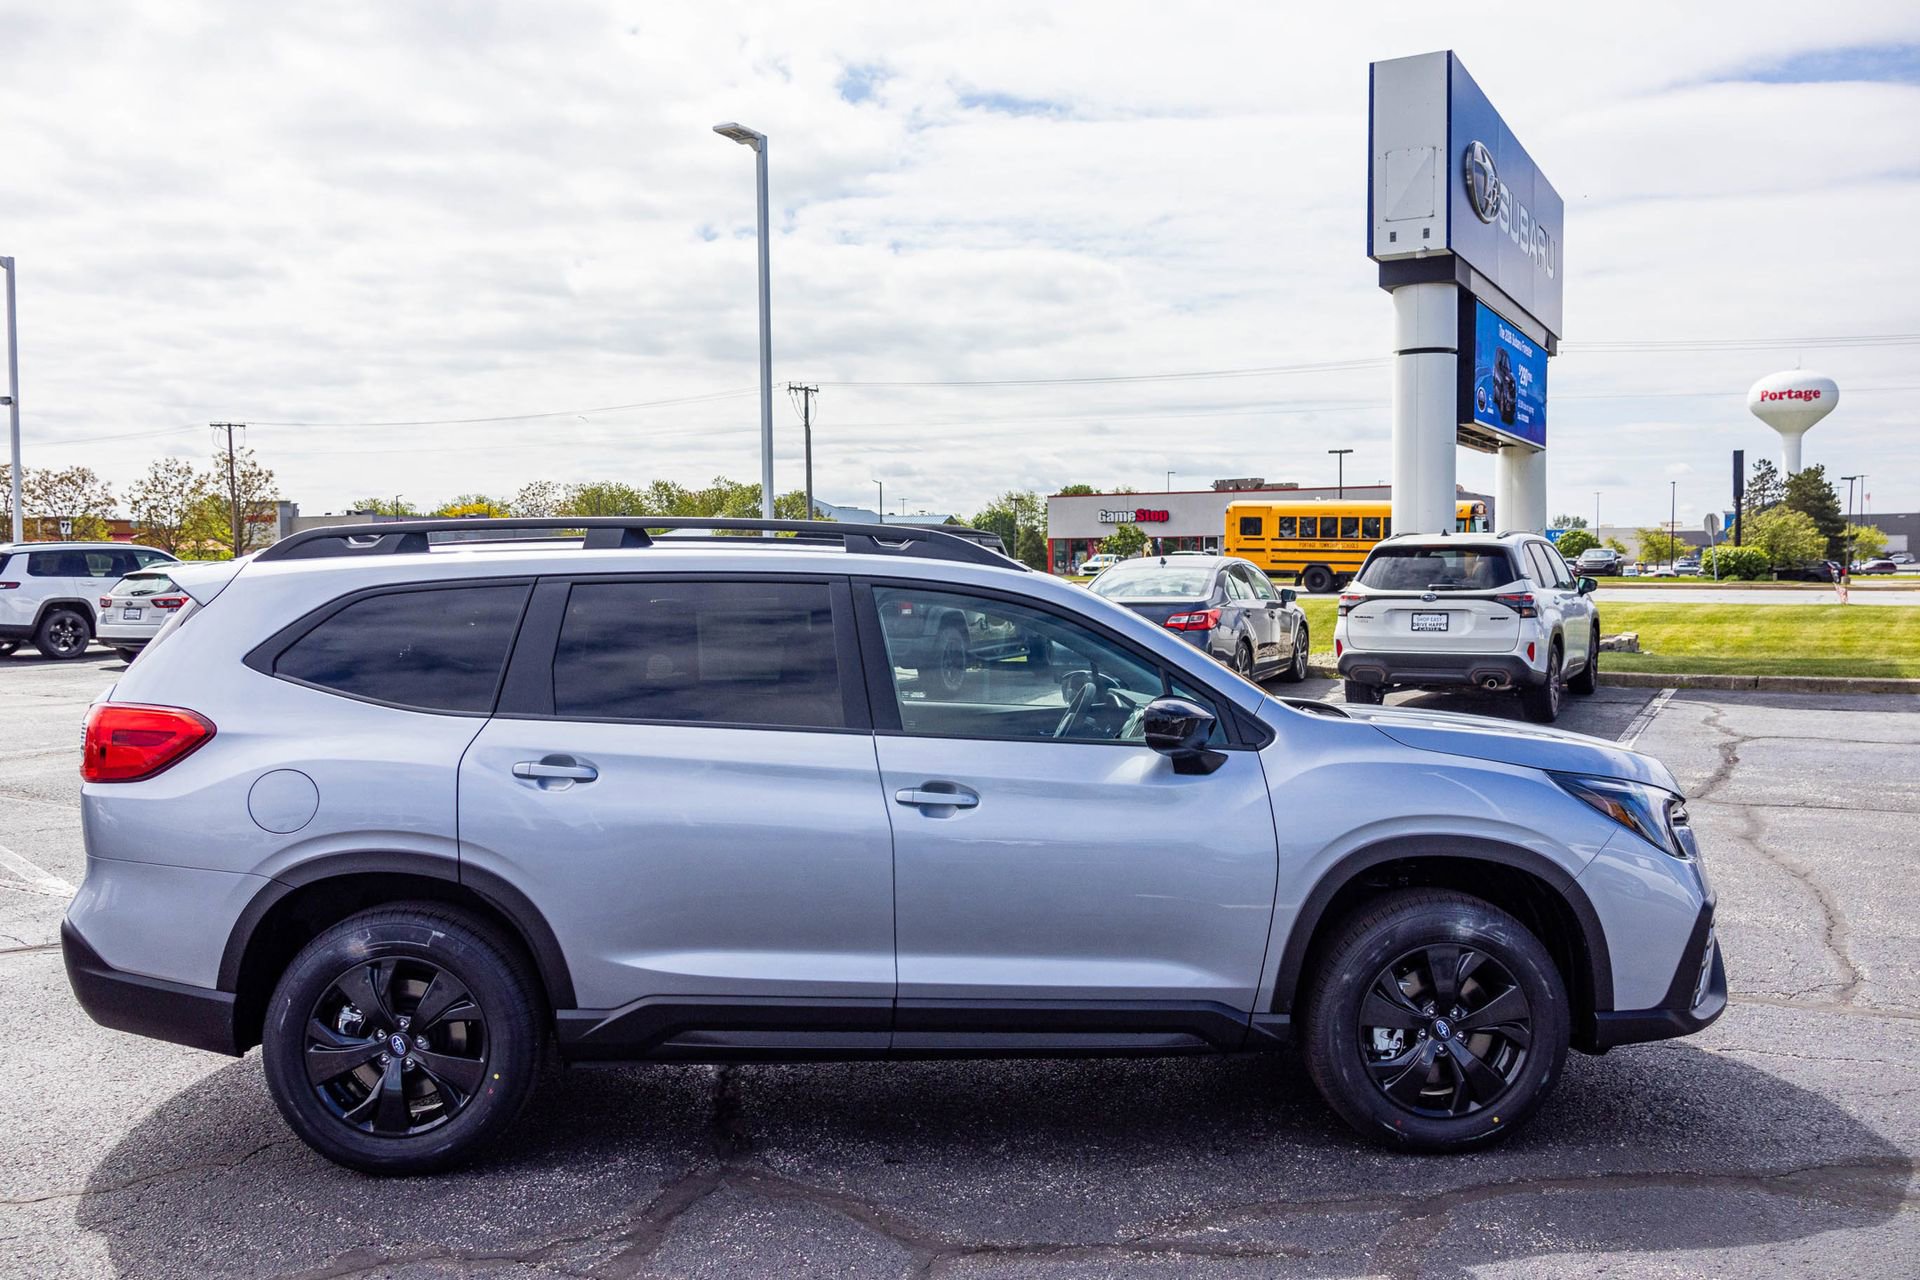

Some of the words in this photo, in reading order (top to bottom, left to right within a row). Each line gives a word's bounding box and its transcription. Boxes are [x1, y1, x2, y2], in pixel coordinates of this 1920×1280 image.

[1498, 182, 1556, 280] SUBARU
[1760, 389, 1821, 402] Portage
[1098, 508, 1169, 523] GameStop
